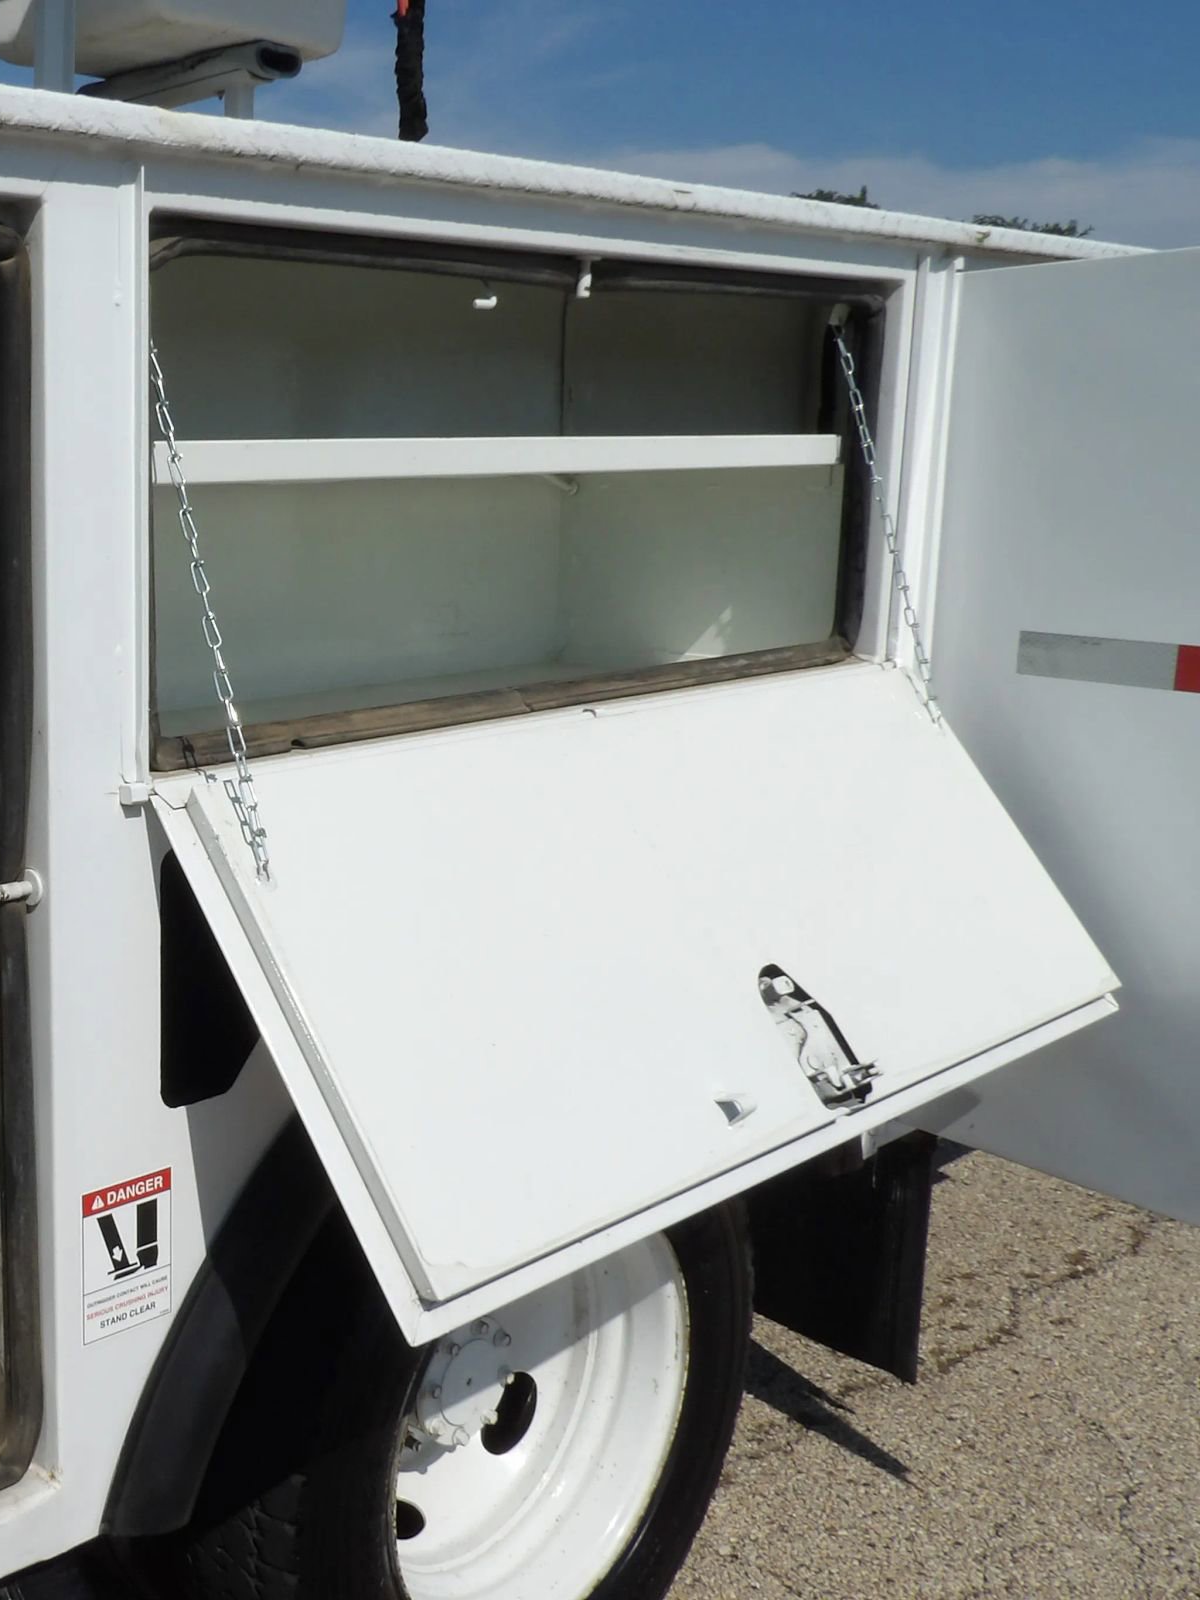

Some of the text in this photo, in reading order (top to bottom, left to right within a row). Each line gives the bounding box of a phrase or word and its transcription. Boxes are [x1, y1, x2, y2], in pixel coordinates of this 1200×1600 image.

[107, 1175, 163, 1205] DANGER
[86, 1306, 114, 1320] SERIOUS
[115, 1294, 146, 1311] CRUSHING
[147, 1286, 168, 1299] INJURY
[116, 1286, 139, 1298] CONTACT
[100, 1301, 156, 1329] STAND CLEAR
